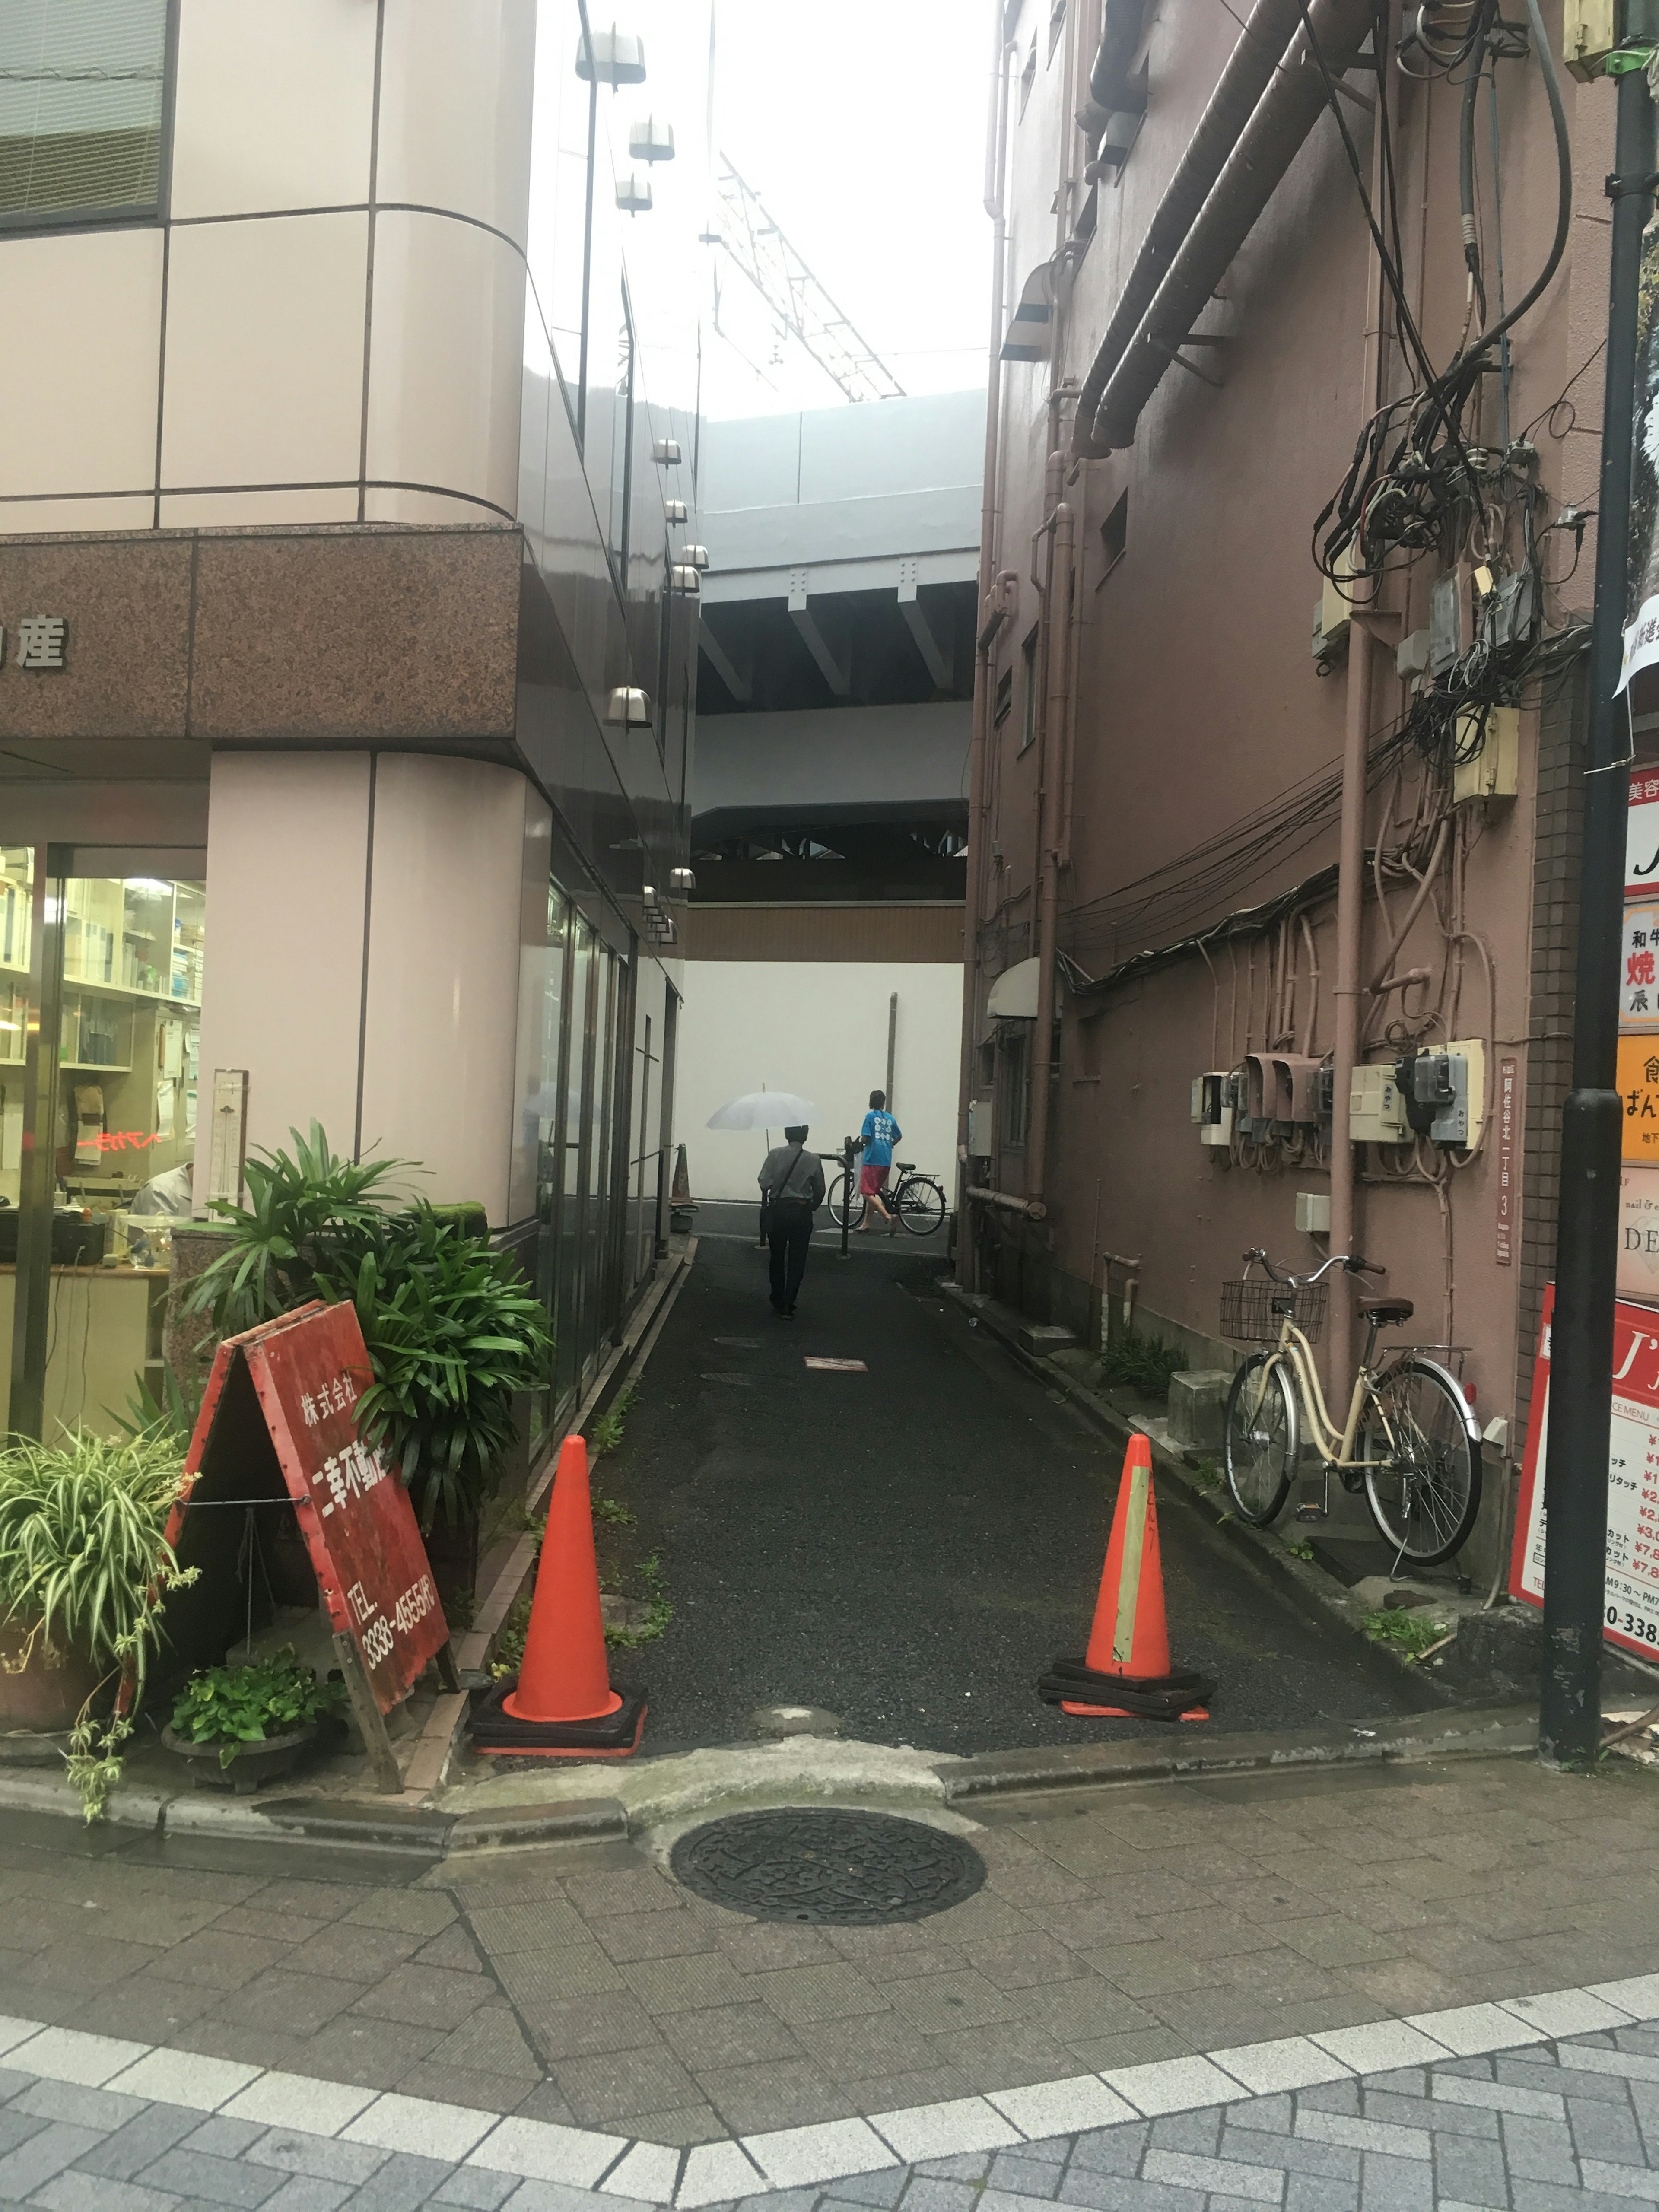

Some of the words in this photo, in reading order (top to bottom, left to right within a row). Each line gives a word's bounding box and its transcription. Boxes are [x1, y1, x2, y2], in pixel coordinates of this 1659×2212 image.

[0, 614, 64, 667] 産
[1629, 779, 1659, 801] 美容
[1632, 929, 1659, 948] 和牛
[1626, 951, 1656, 985] 焼
[1630, 989, 1659, 1012] 辰
[1383, 1086, 1392, 1109] おやつ
[1620, 1089, 1659, 1118] ばん
[1501, 1078, 1513, 1187] 阿佐谷北一丁目
[1642, 1132, 1659, 1144] 地下
[1501, 1195, 1507, 1216] 3
[1626, 1199, 1641, 1209] nail
[1624, 1227, 1659, 1253] DE
[302, 1370, 358, 1428] 株式会社
[1624, 1405, 1649, 1421] MENU
[1607, 1529, 1630, 1544] カット
[1535, 1543, 1547, 1553] 年
[1533, 1576, 1545, 1590] TEL
[1605, 1576, 1632, 1595] M9:30
[1607, 1606, 1659, 1646] 0-338
